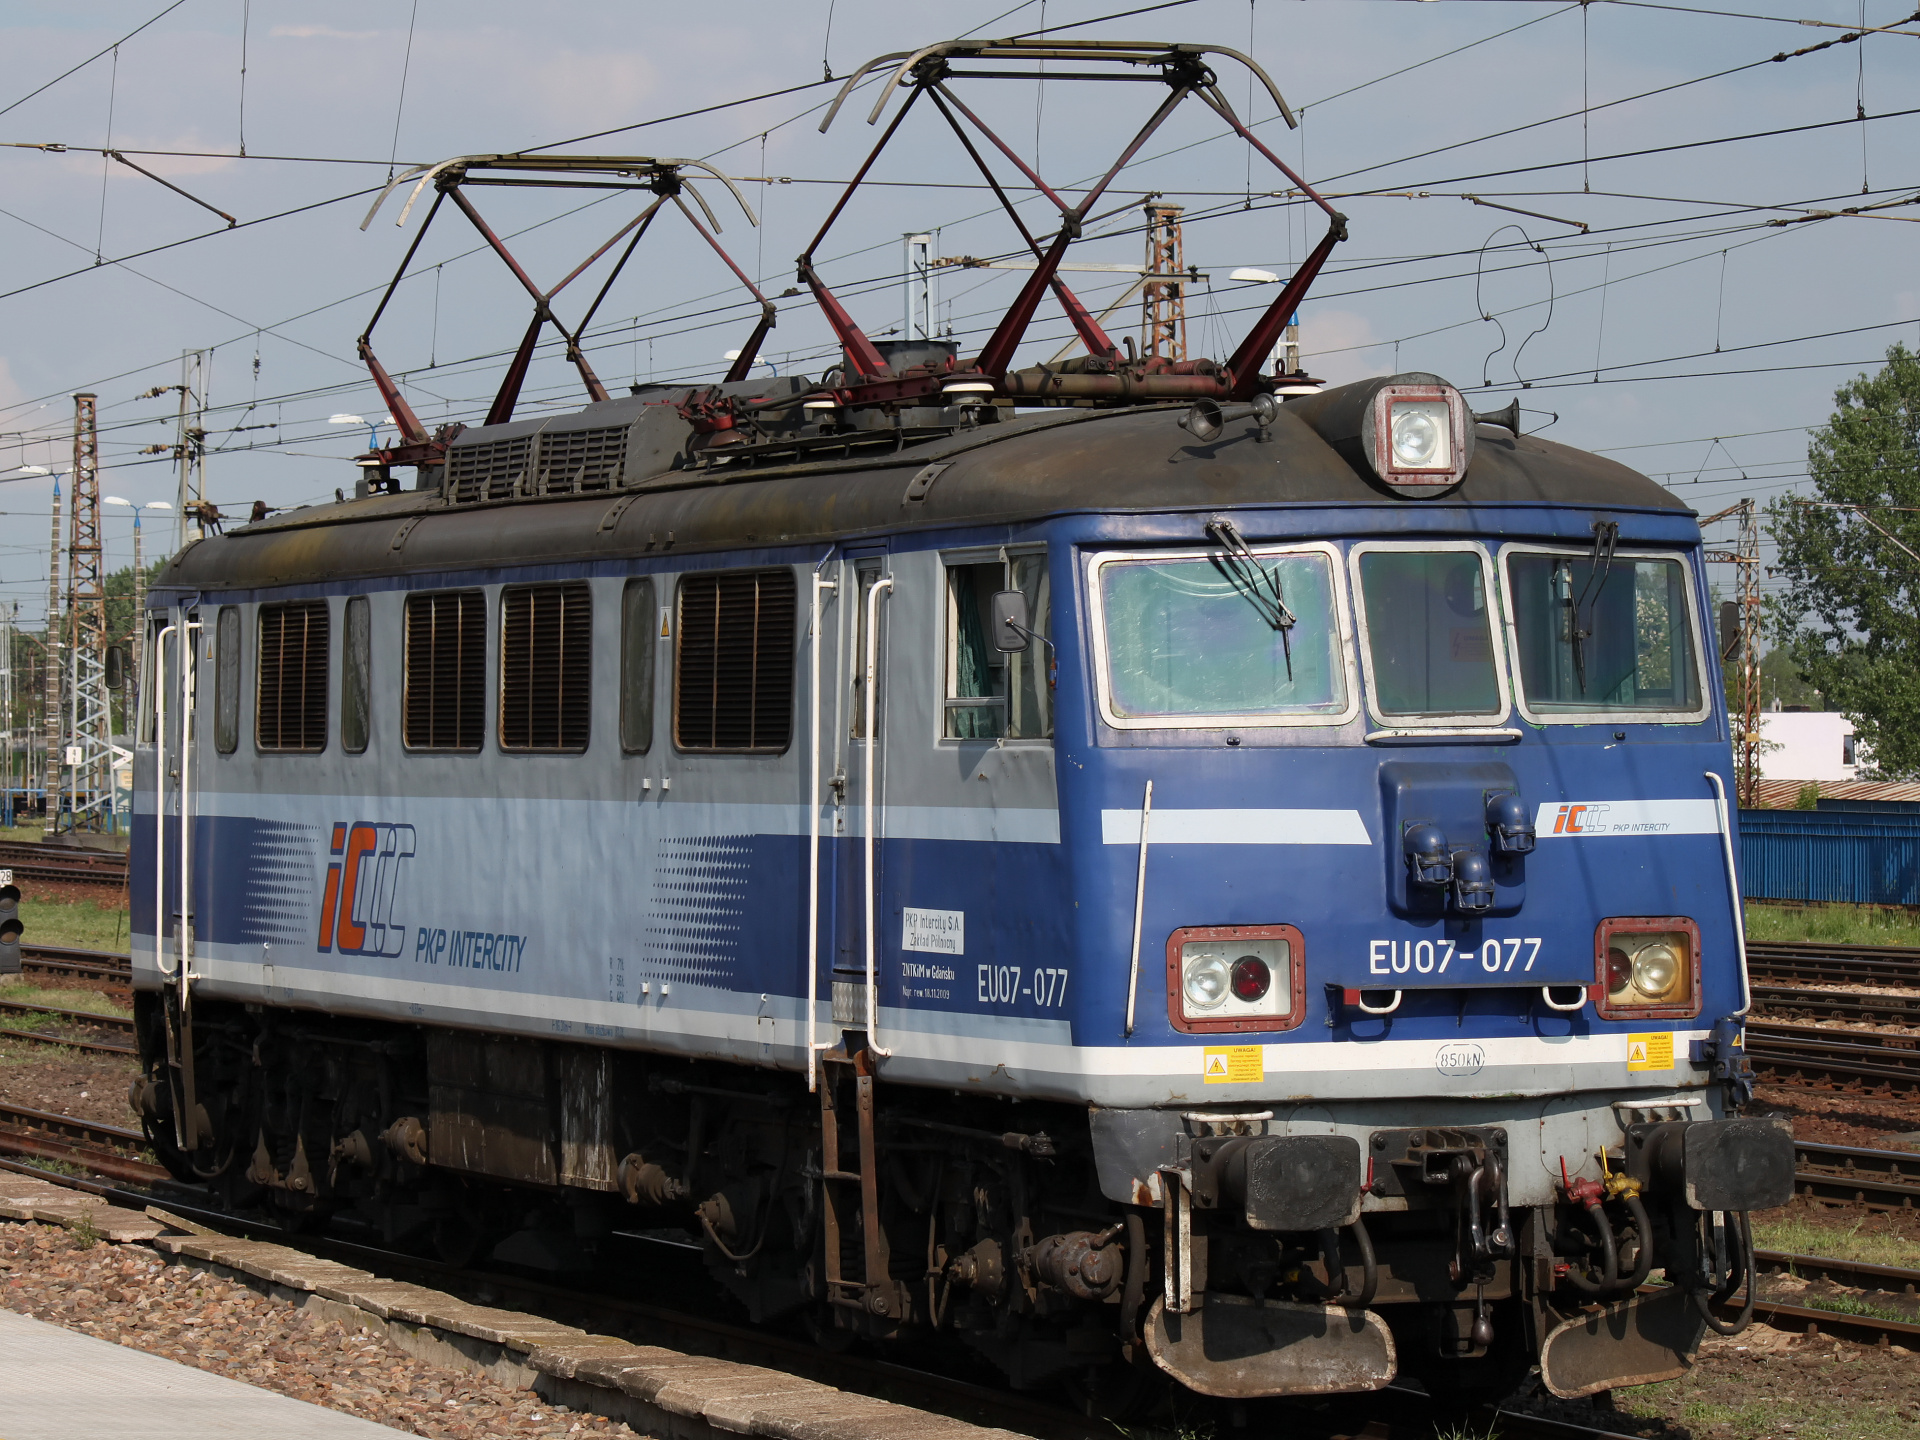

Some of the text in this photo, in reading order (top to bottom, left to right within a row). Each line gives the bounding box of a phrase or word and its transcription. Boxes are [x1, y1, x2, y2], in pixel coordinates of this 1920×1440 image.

[1613, 823, 1670, 832] PKP INTERCITY
[905, 912, 961, 934] PKP Intercity S.A.
[910, 932, 930, 947] Zakład
[415, 927, 528, 973] PKP INTERCITY
[1370, 937, 1542, 974] EU07-077
[926, 968, 931, 978] w
[932, 964, 955, 980] Gdańsku
[978, 964, 1068, 1008] EU07-077
[1440, 1053, 1480, 1067] 850kN
